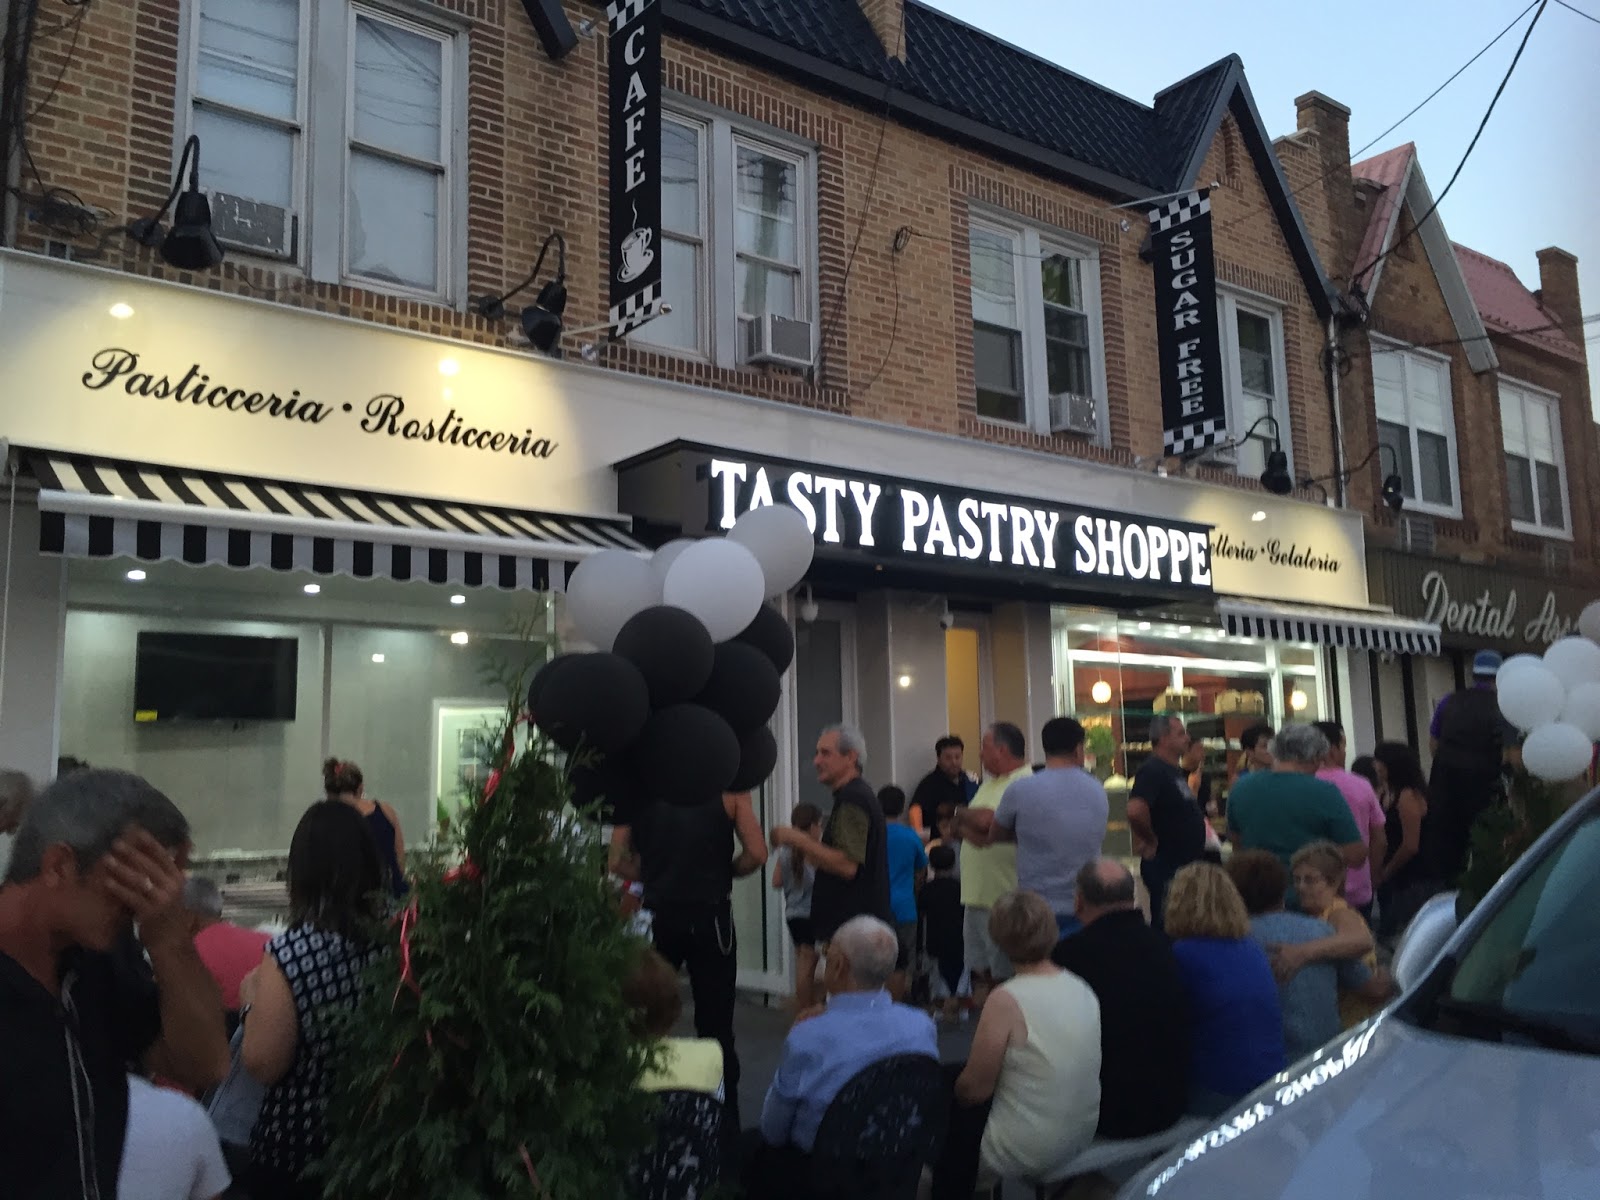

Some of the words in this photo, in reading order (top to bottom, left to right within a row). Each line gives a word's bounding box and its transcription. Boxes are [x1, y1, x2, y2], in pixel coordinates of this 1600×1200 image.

[624, 25, 647, 193] CAFE
[1170, 230, 1201, 331] SUGAR
[82, 347, 333, 425] Pasticceria
[360, 393, 559, 460] Rosticceria
[1177, 337, 1205, 417] FREE
[711, 458, 881, 547] TASTY
[900, 488, 1059, 569] PASTRY
[1074, 515, 1211, 586] SHOPPE
[1266, 538, 1341, 574] Gelateria
[1421, 570, 1516, 640] Dental
